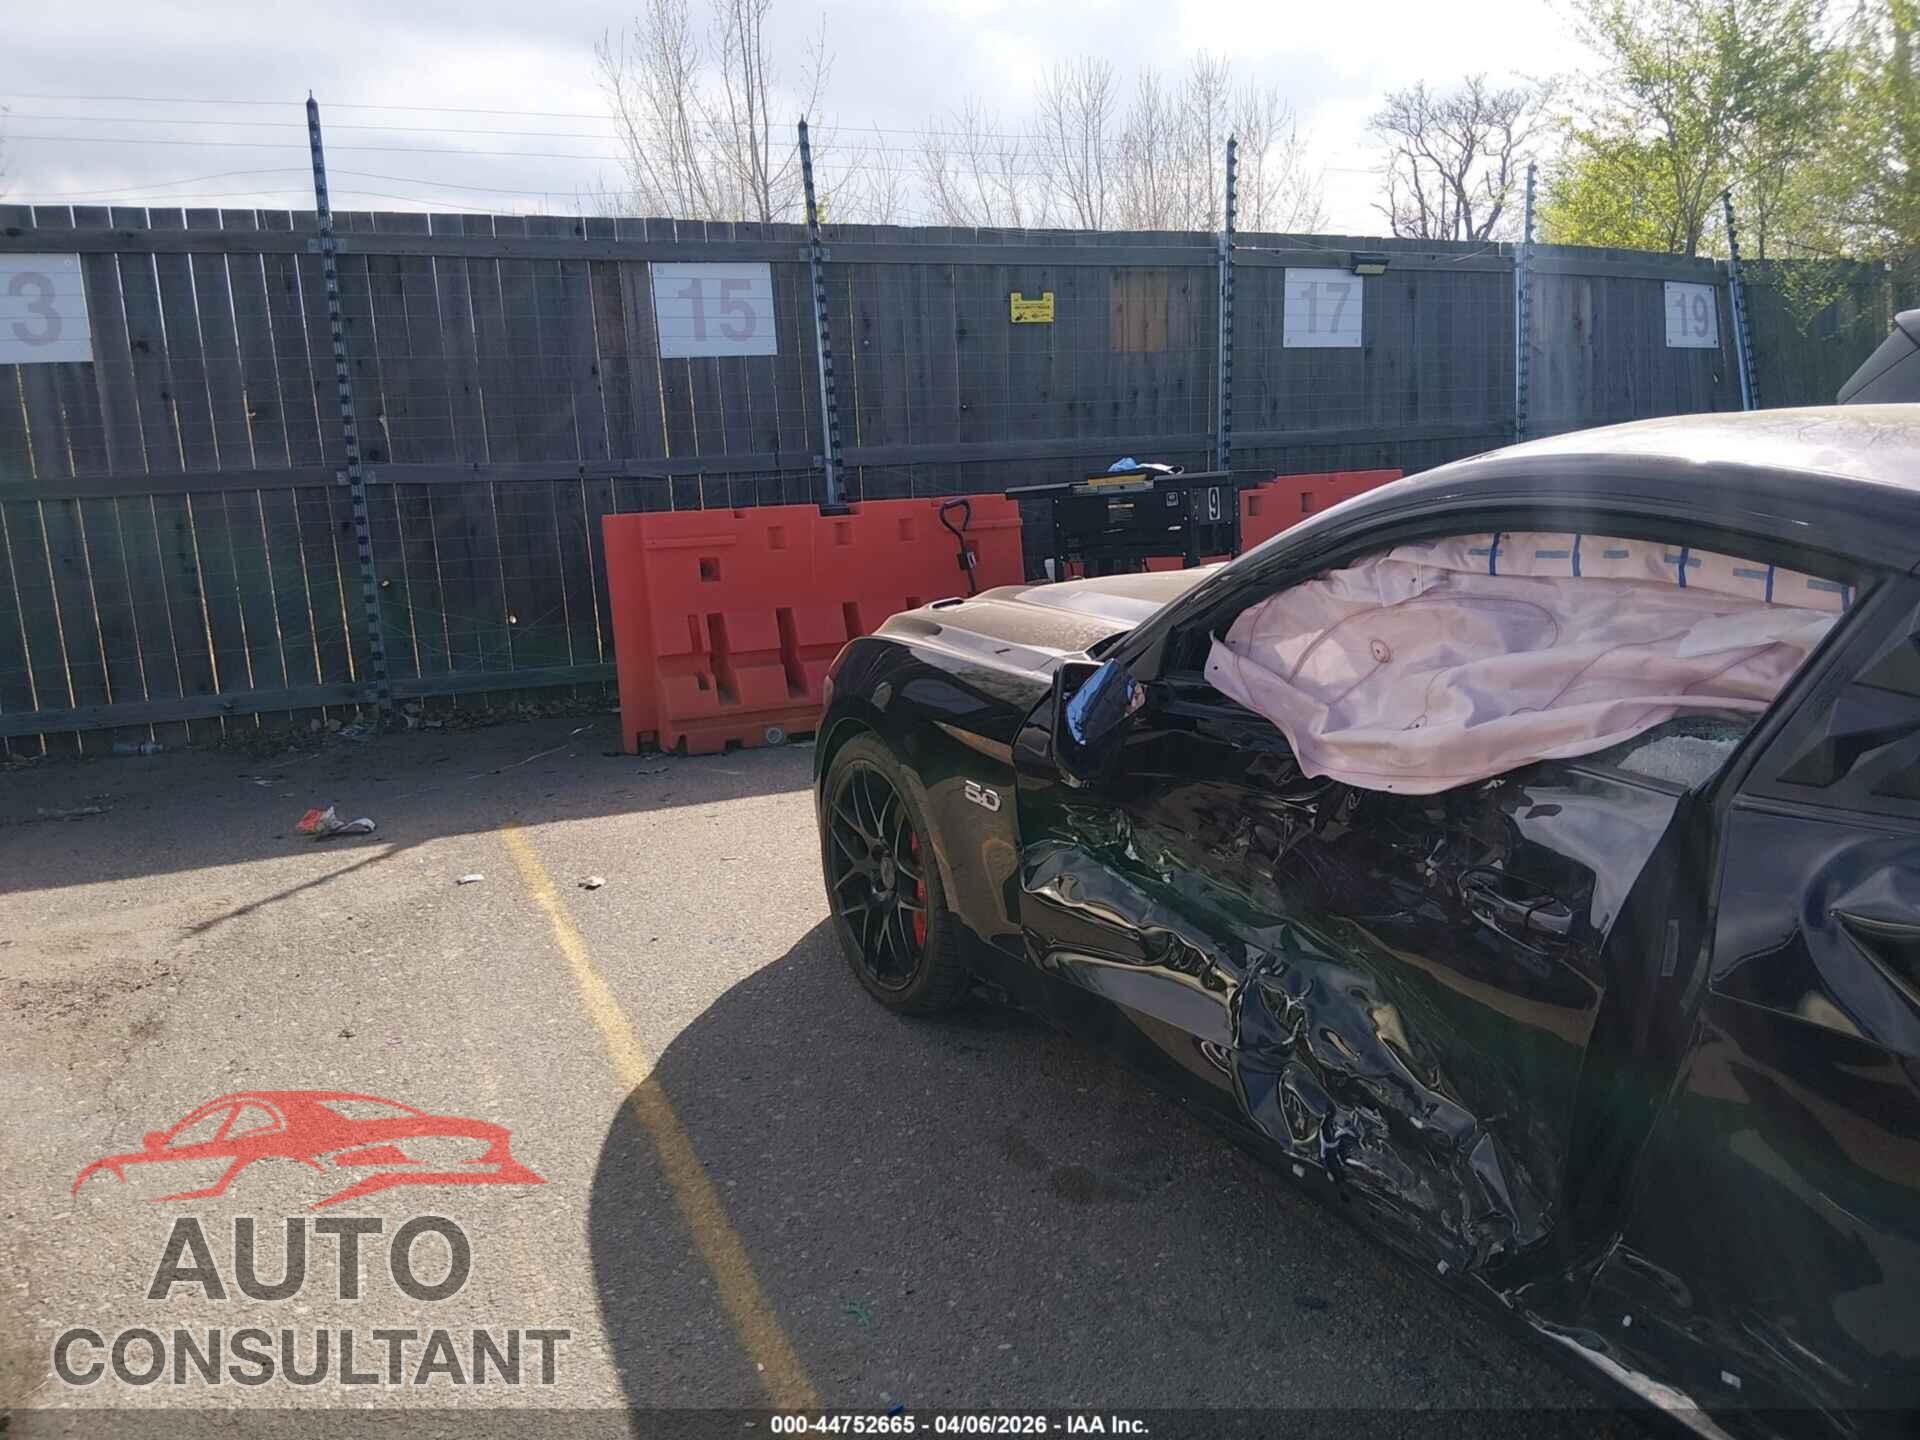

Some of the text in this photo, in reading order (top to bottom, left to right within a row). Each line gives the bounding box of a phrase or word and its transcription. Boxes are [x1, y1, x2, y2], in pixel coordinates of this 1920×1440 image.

[676, 278, 756, 342] 15
[1301, 281, 1351, 334] 17
[1673, 293, 1709, 338] 19
[1208, 487, 1221, 520] 9
